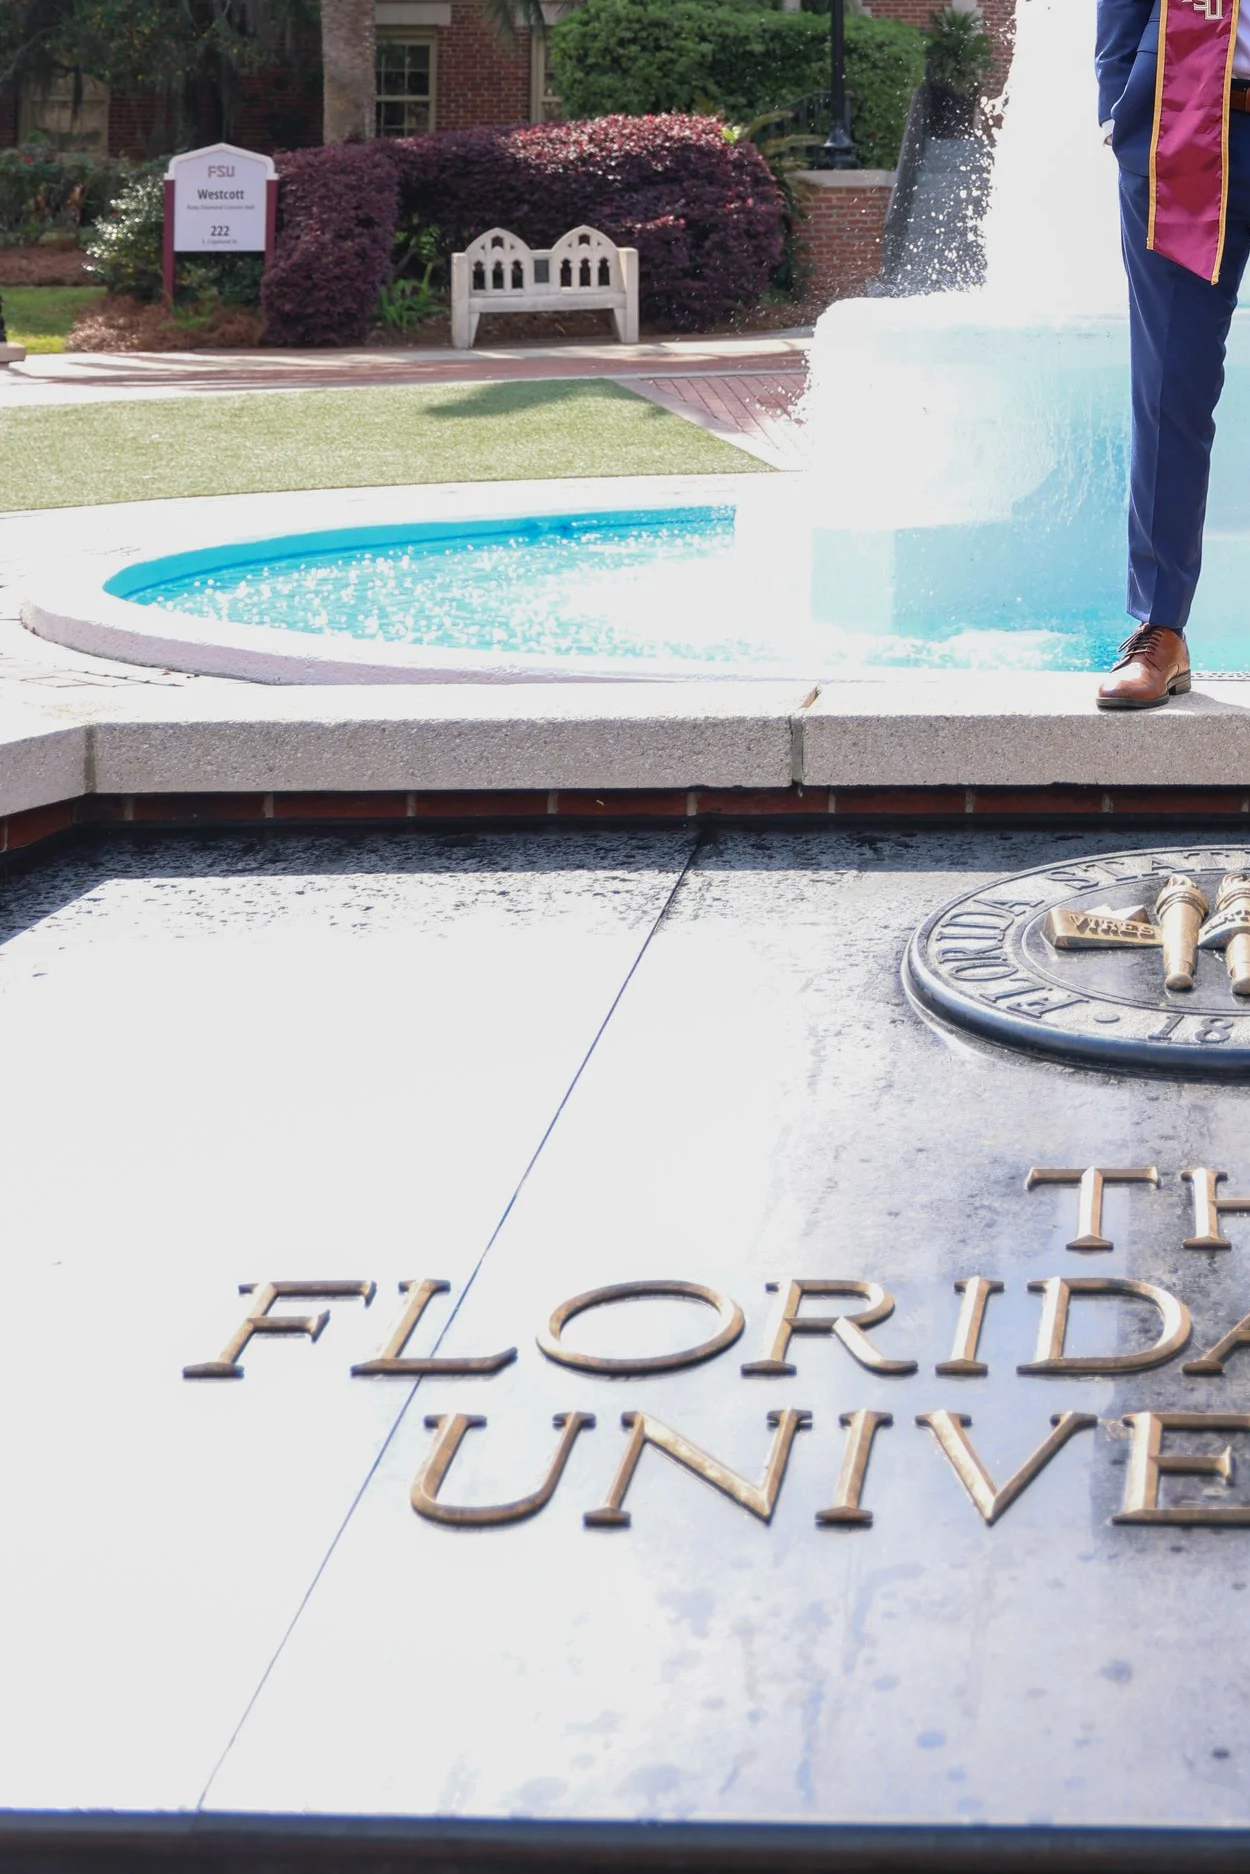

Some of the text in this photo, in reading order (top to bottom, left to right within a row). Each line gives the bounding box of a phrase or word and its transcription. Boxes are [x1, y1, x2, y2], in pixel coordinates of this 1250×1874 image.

[207, 165, 236, 178] FSU
[197, 189, 245, 200] Westcott
[210, 225, 229, 237] 222
[935, 898, 1089, 1019] FLORIDA
